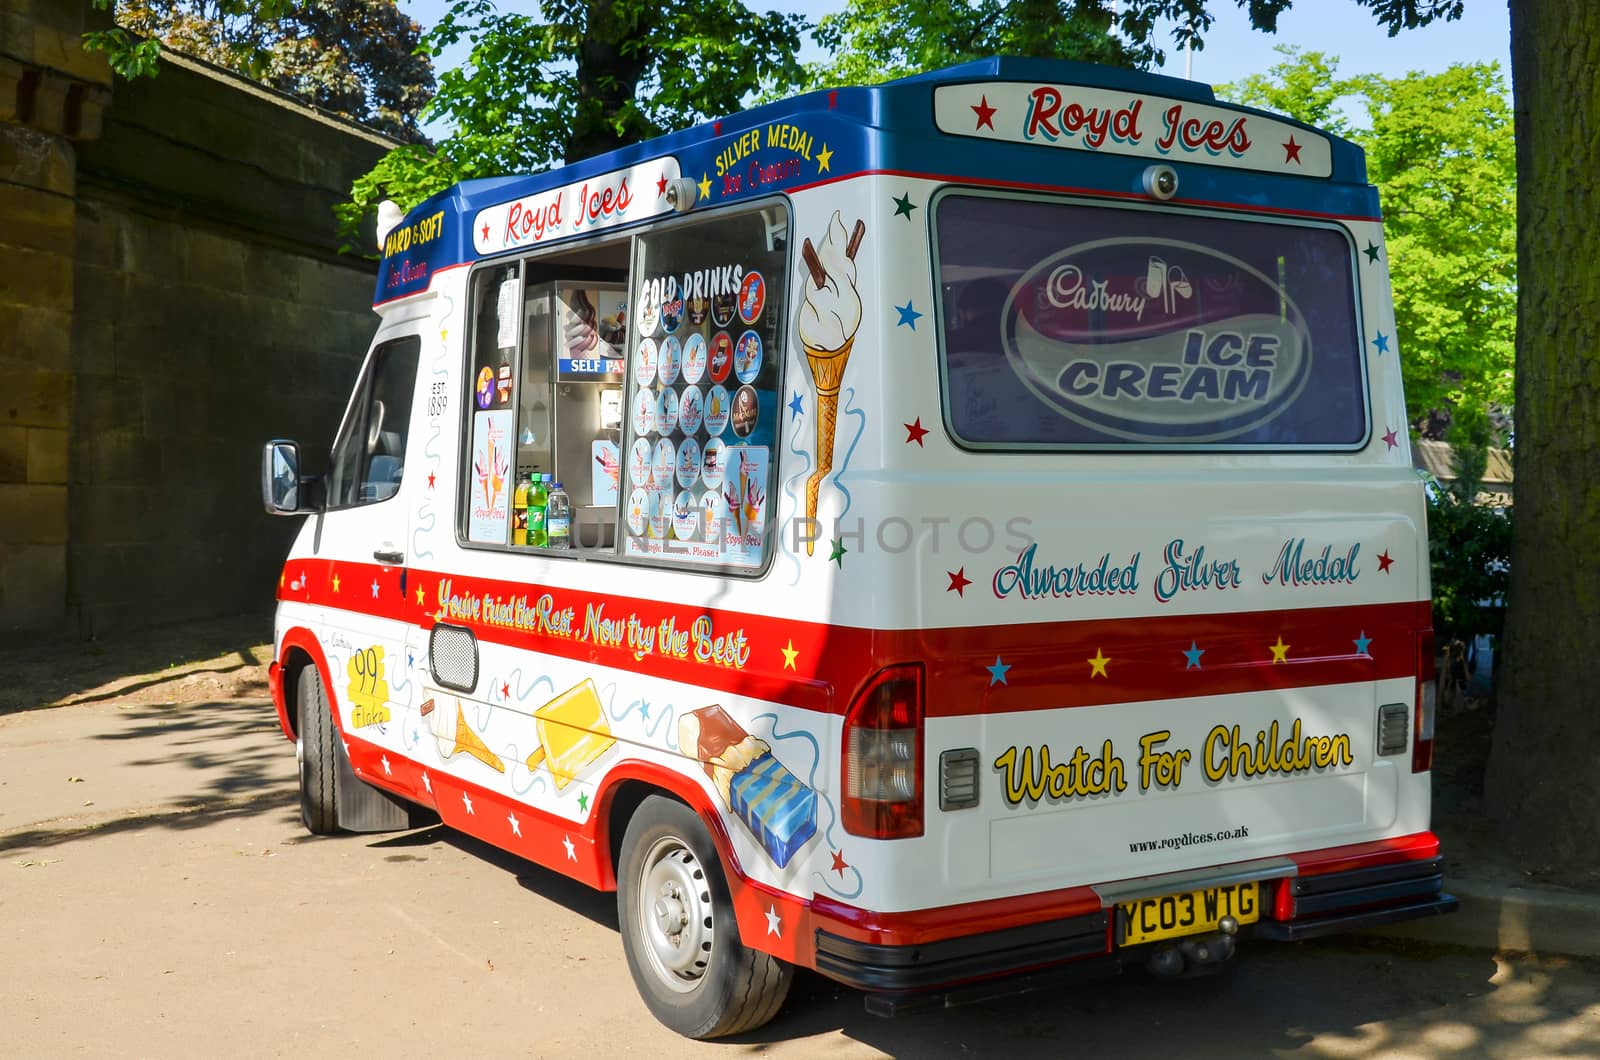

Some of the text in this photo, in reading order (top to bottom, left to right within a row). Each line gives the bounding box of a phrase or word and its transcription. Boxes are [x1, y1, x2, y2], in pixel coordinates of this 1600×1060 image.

[1024, 87, 1252, 158] Royd Ices
[715, 124, 814, 177] SILVER MEDAL
[721, 159, 800, 196] Ice Cream
[385, 226, 412, 259] HARD
[420, 210, 445, 244] SOFT
[504, 176, 634, 247] Royd Ices
[639, 264, 743, 305] COLD DRINKS
[1046, 264, 1147, 321] Cadbury
[571, 360, 600, 372] SELF
[1183, 330, 1279, 367] ICE
[1056, 359, 1271, 401] CREAM
[993, 537, 1361, 602] Awarded Silver Medal
[482, 593, 515, 627] tried
[514, 595, 537, 630] the
[581, 602, 627, 646] Now
[628, 613, 656, 662] try
[658, 616, 689, 657] the
[692, 615, 751, 670] Best
[355, 648, 377, 695] 99
[355, 704, 388, 736] Flake
[994, 718, 1354, 805] Watch For Children
[1129, 826, 1249, 852] www.roydices.co.uk
[1122, 883, 1254, 937] YC03 WTG
